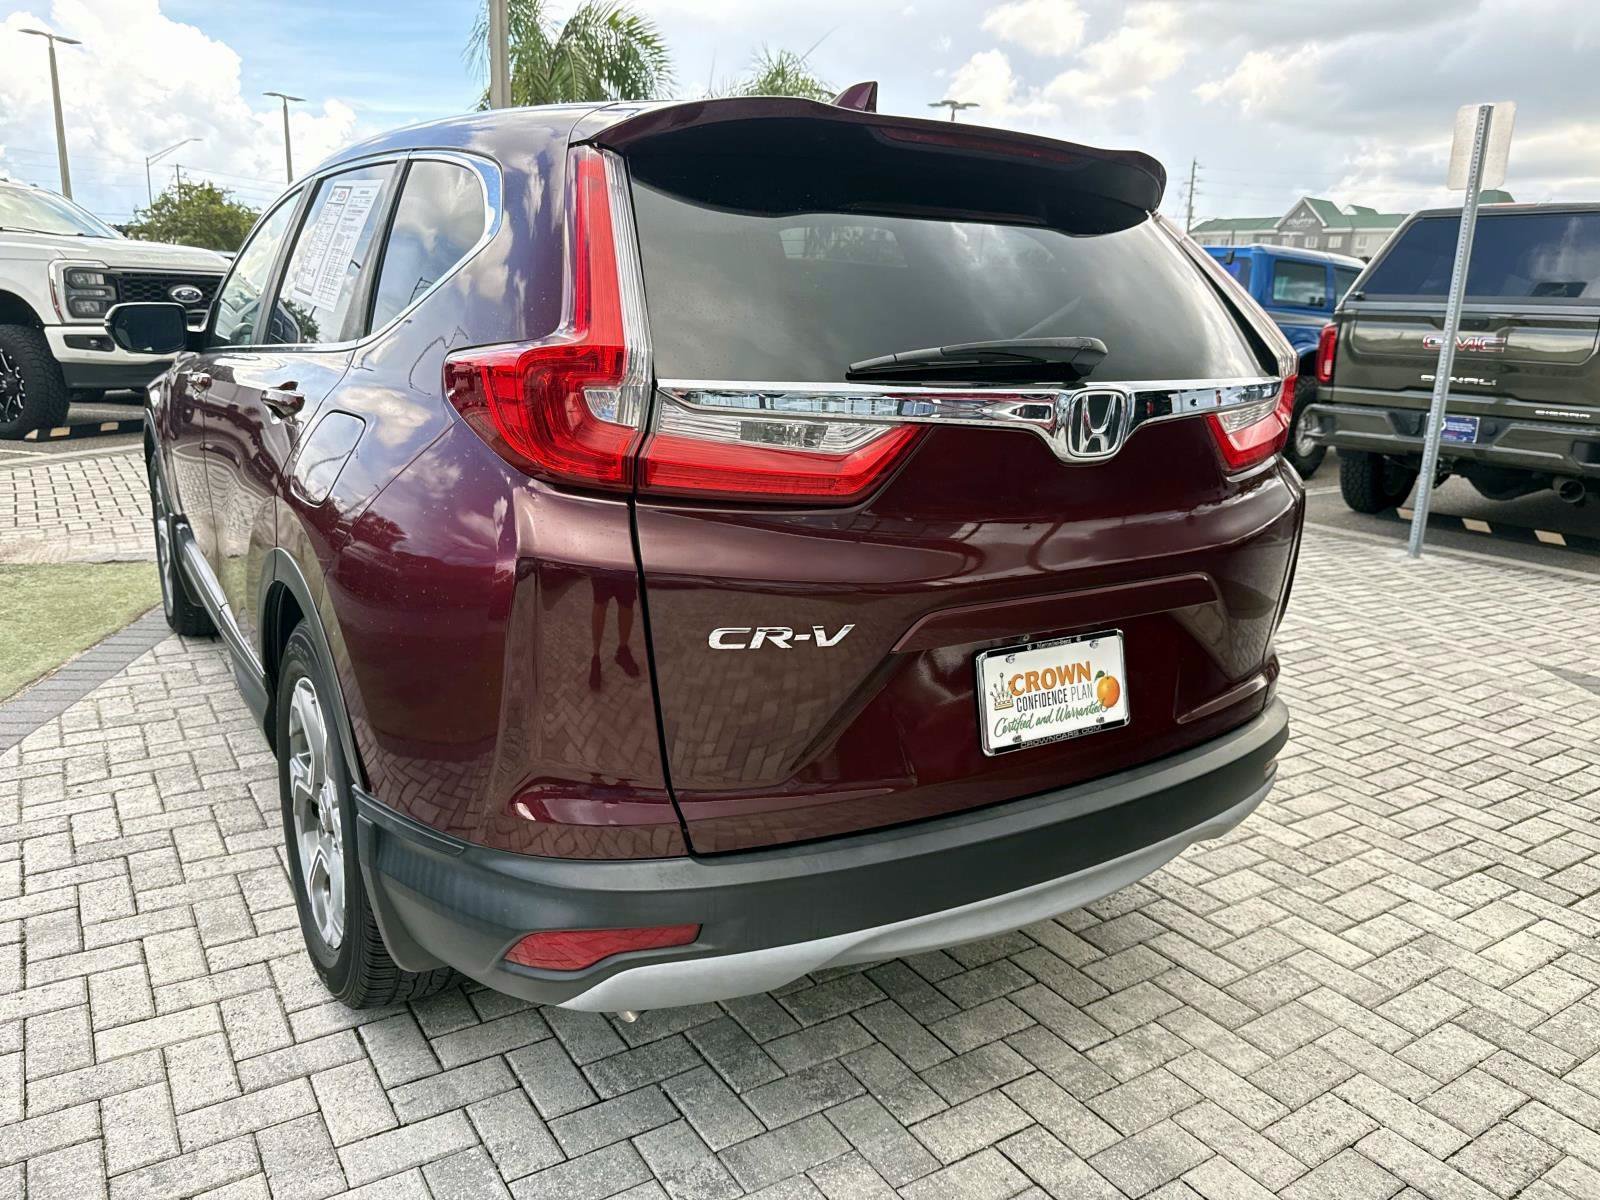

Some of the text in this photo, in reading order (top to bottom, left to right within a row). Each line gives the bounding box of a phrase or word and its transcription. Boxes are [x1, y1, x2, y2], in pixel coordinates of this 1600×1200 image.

[1420, 374, 1497, 386] DNALI
[708, 623, 856, 650] CR-V
[1009, 661, 1092, 696] CROWN
[1016, 683, 1093, 713] CONFIDENCE PLAN
[994, 712, 1035, 738] Certified
[1035, 708, 1055, 726] and
